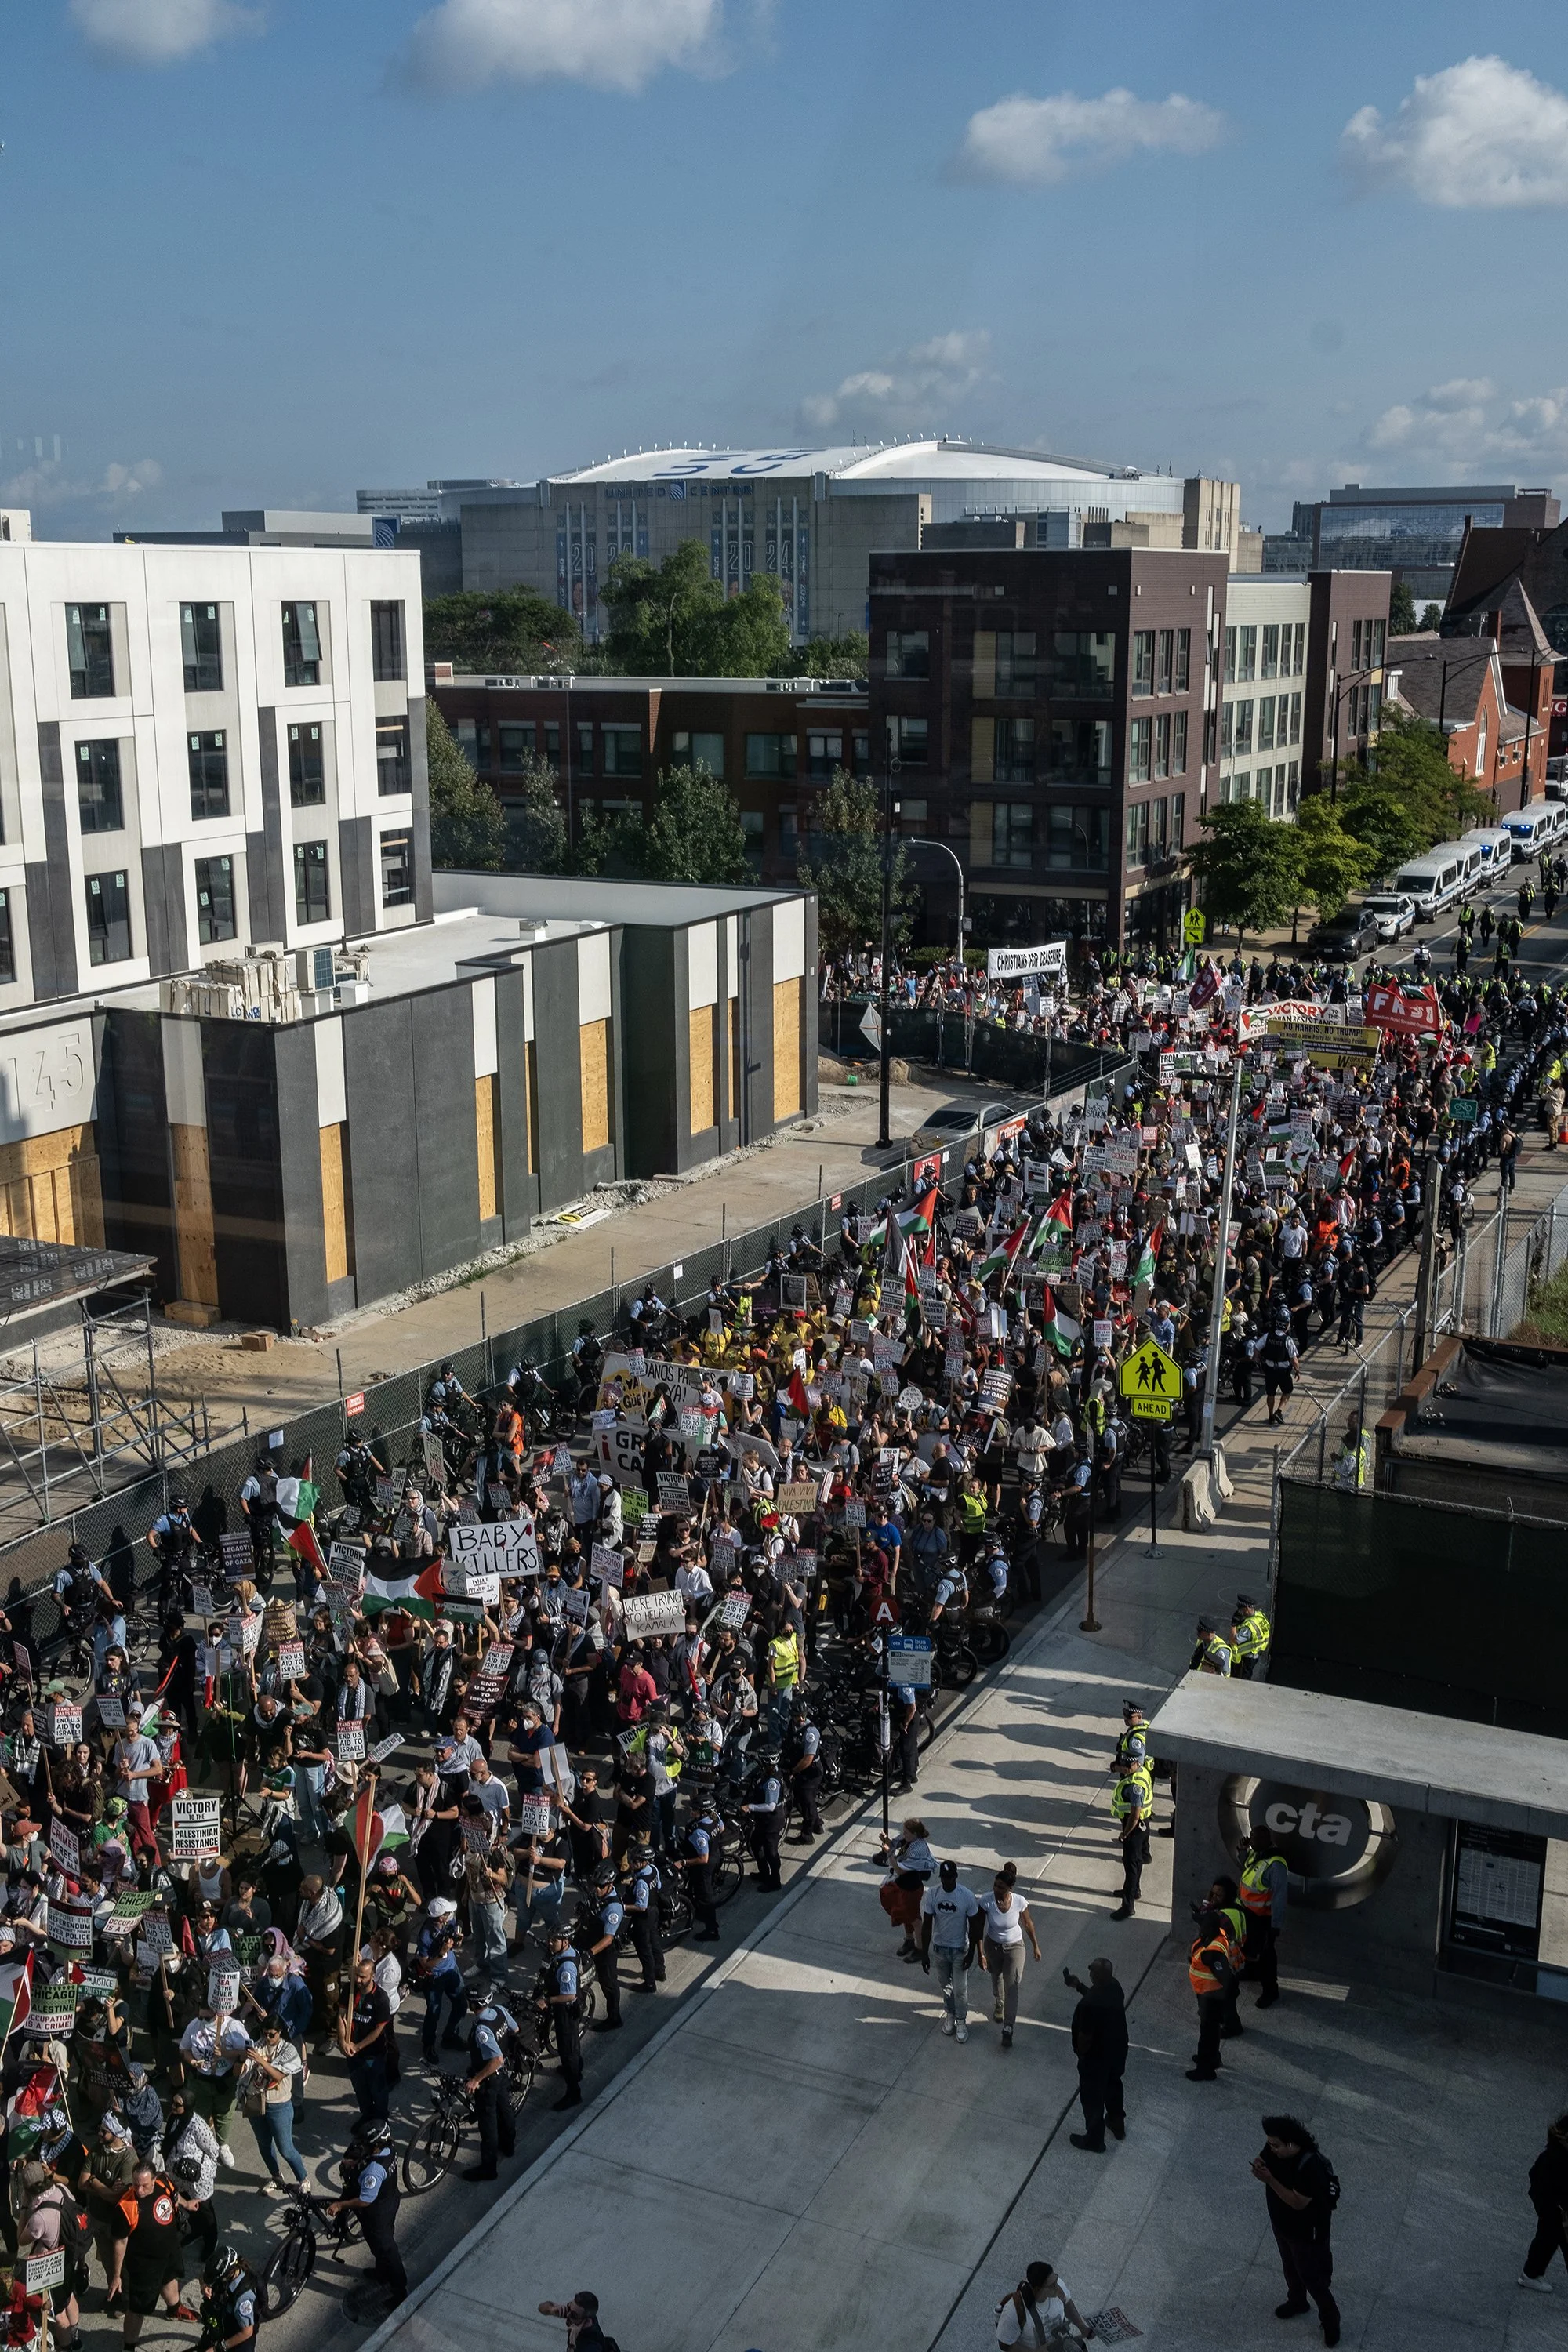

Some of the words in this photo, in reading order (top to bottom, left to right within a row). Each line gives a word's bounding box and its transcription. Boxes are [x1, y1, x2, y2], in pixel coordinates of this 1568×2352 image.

[606, 487, 666, 498] UNITED
[691, 485, 753, 496] CENTER
[997, 953, 1027, 971] CHRISTIANS
[1029, 953, 1038, 968] FOR
[1040, 948, 1061, 967] CEASEFIRE
[1266, 1002, 1329, 1018] VICTORY
[1283, 1022, 1293, 1031] NO
[1325, 1025, 1333, 1035] NO
[1337, 1027, 1363, 1038] TRUMP!
[7, 1033, 83, 1120] 145
[883, 1279, 903, 1290] VICTORY
[991, 1392, 1007, 1401] GAZA
[1137, 1403, 1167, 1414] AHEAD
[659, 1473, 685, 1484] VICTORY
[622, 1490, 634, 1499] END
[661, 1492, 688, 1501] PALESTINIAN
[782, 1486, 797, 1496] VIVA
[800, 1485, 815, 1496] VIVA
[662, 1498, 689, 1507] RESISTANCE
[779, 1497, 815, 1511] PALESTINA
[457, 1524, 530, 1551] BABY
[334, 1543, 362, 1560] VICTORY
[234, 1557, 252, 1566] GAZA
[455, 1548, 537, 1577] KILLERS
[330, 1563, 360, 1577] PALESTINIAN
[329, 1570, 360, 1586] RESISTANCE
[652, 1591, 681, 1608] TRYING
[628, 1612, 641, 1624] TO
[644, 1608, 664, 1621] HELP
[666, 1606, 681, 1617] YOU
[724, 1611, 744, 1621] ISRAEL!
[876, 1602, 894, 1622] A
[637, 1618, 677, 1633] KAMALA
[691, 1764, 712, 1773] GAZA
[176, 1800, 217, 1814] VICTORY
[524, 1819, 547, 1828] ISRAEL!
[1265, 1802, 1352, 1846] cta
[52, 1826, 78, 1853] CRIMES
[175, 1828, 218, 1839] PALESTINIAN
[176, 1837, 219, 1849] RESISTANCE
[55, 1842, 72, 1860] FREE
[66, 1860, 78, 1872] ALL
[49, 1908, 76, 1922] SUPPORT
[49, 1915, 90, 1930] REFERENDUM
[49, 1925, 64, 1937] OVER
[65, 1932, 90, 1940] POLICE
[147, 1936, 171, 1945] ISRAEL!
[92, 1976, 113, 1987] JUSTICE
[84, 1986, 111, 1997] PALESTINE
[45, 2020, 72, 2031] CRIME!
[28, 2254, 62, 2267] IMMIGRANT
[28, 2263, 49, 2273] RIGHTS
[28, 2263, 62, 2276] LEGALIZATION
[45, 2267, 62, 2276] ALL!
